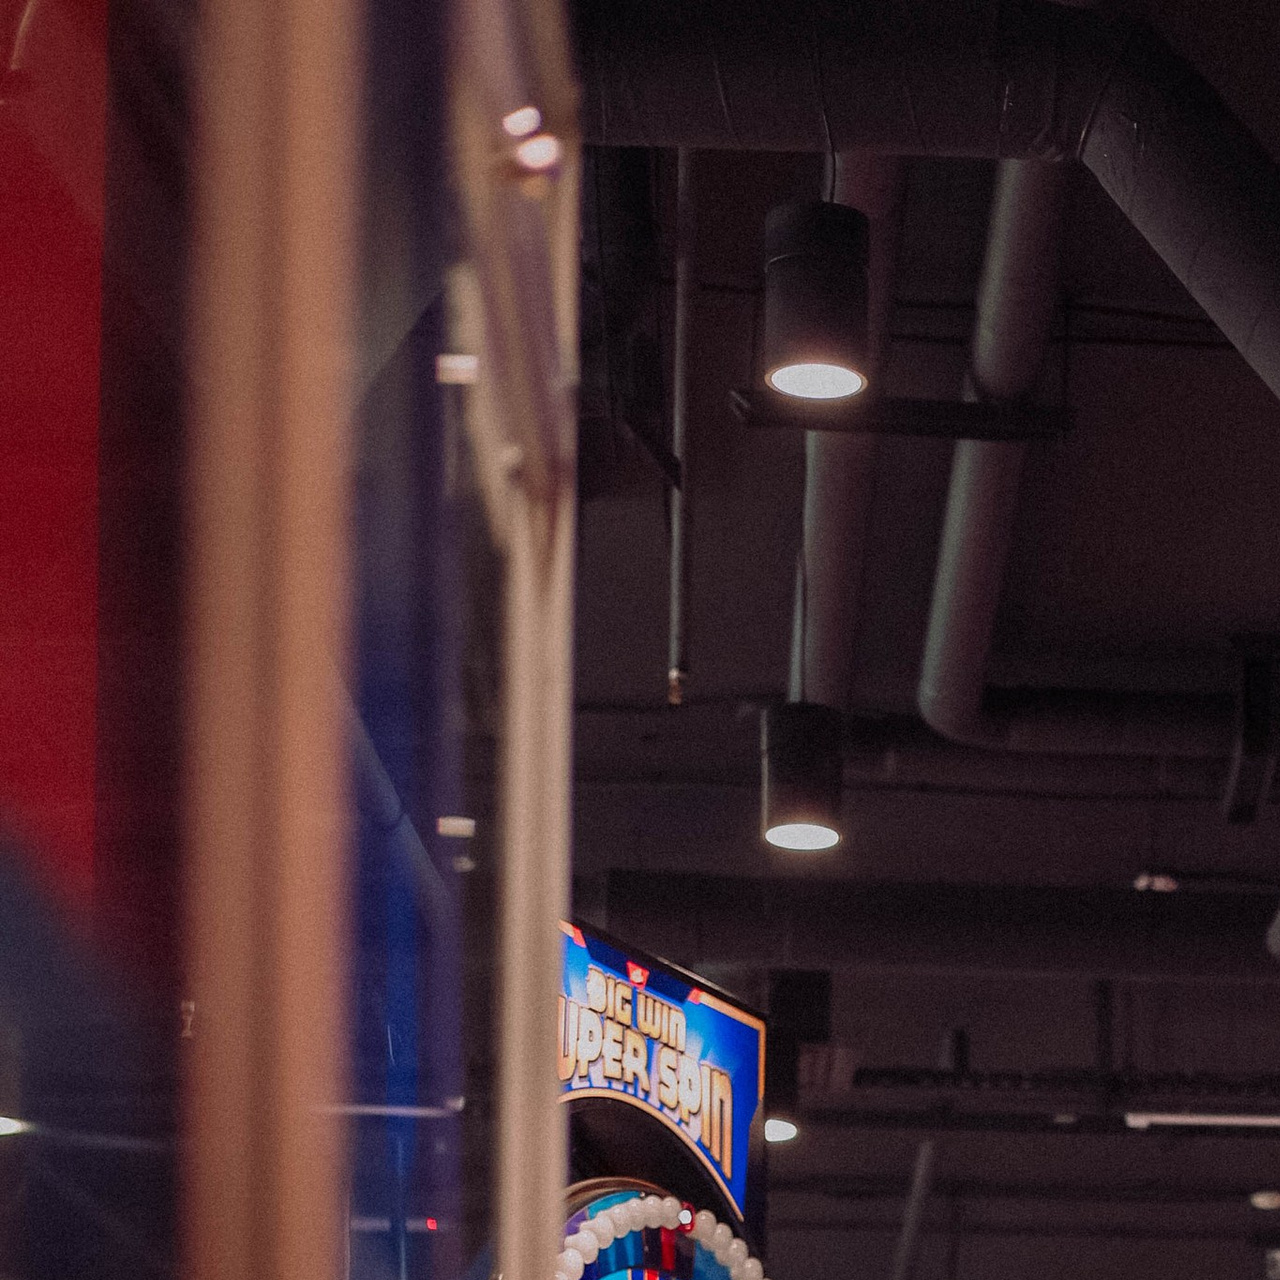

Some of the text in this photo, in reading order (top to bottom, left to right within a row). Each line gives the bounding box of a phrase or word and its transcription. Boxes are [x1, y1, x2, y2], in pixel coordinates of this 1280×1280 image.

[586, 963, 687, 1053] BIG WIN
[557, 995, 733, 1181] UPER SPIN
